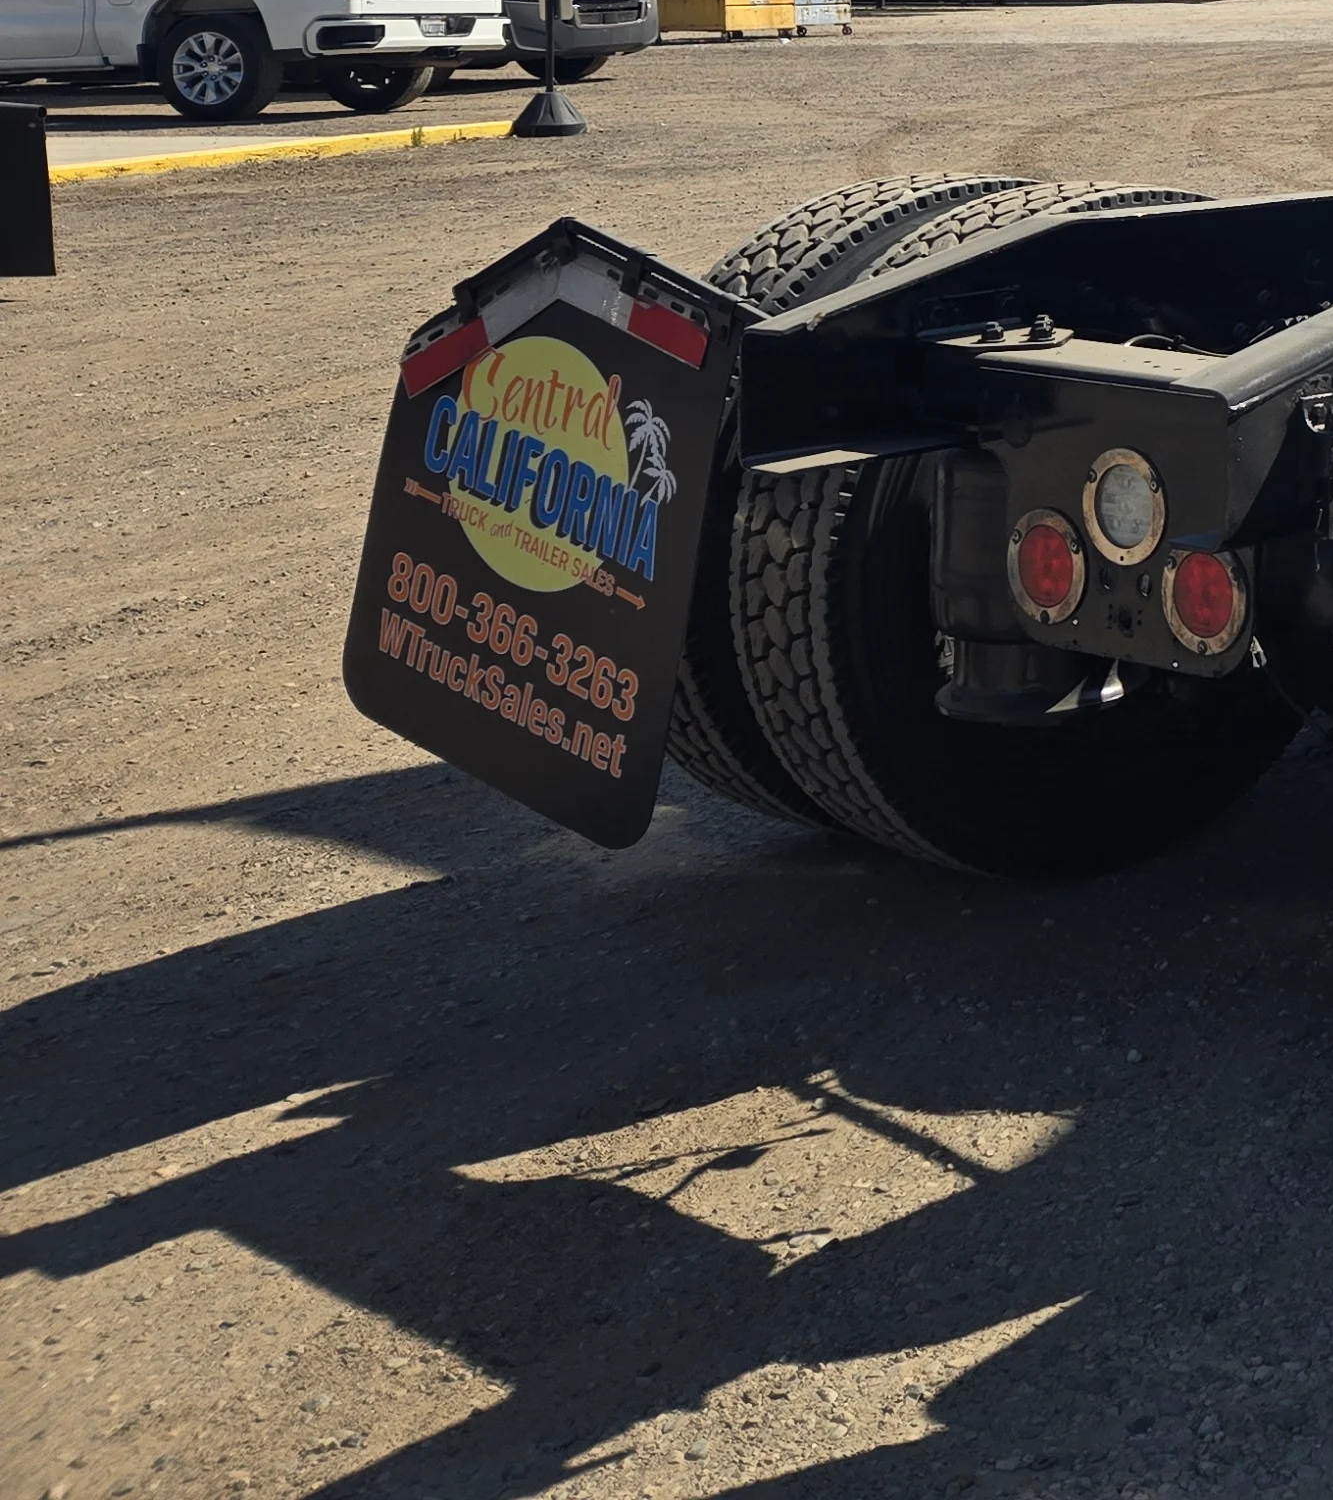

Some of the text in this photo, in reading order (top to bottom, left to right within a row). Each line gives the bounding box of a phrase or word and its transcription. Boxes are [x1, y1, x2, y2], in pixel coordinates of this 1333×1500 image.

[462, 347, 622, 451] Central
[424, 394, 660, 582] CALIFORNIA
[441, 492, 617, 597] TRUCK and TRAILER SALES
[378, 607, 628, 779] WTruckSales.net
[387, 551, 639, 722] 800-366-3263
